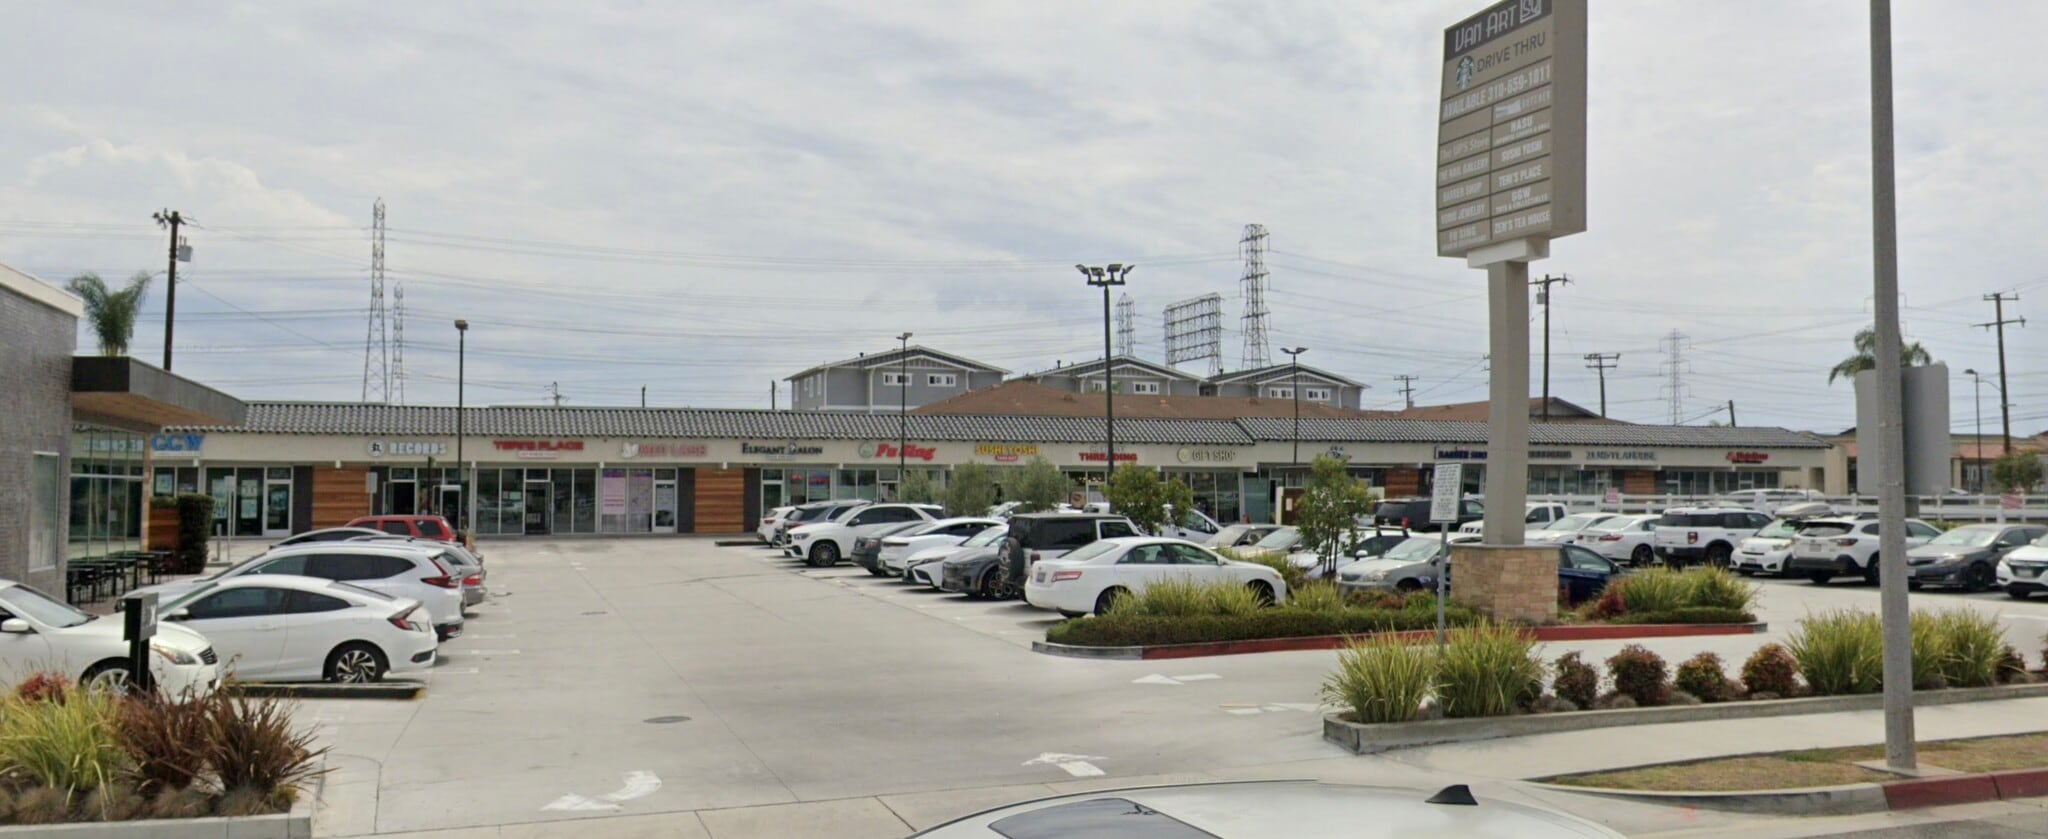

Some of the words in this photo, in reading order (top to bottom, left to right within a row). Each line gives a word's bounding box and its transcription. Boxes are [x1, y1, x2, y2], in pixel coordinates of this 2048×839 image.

[1455, 22, 1482, 52] VAN
[1486, 5, 1518, 38] ART
[1477, 46, 1511, 73] DRIVE
[1513, 32, 1546, 57] THRU
[742, 442, 786, 455] ELEGANT
[976, 444, 1004, 456] SUSHI
[1008, 444, 1041, 456] YOSHI
